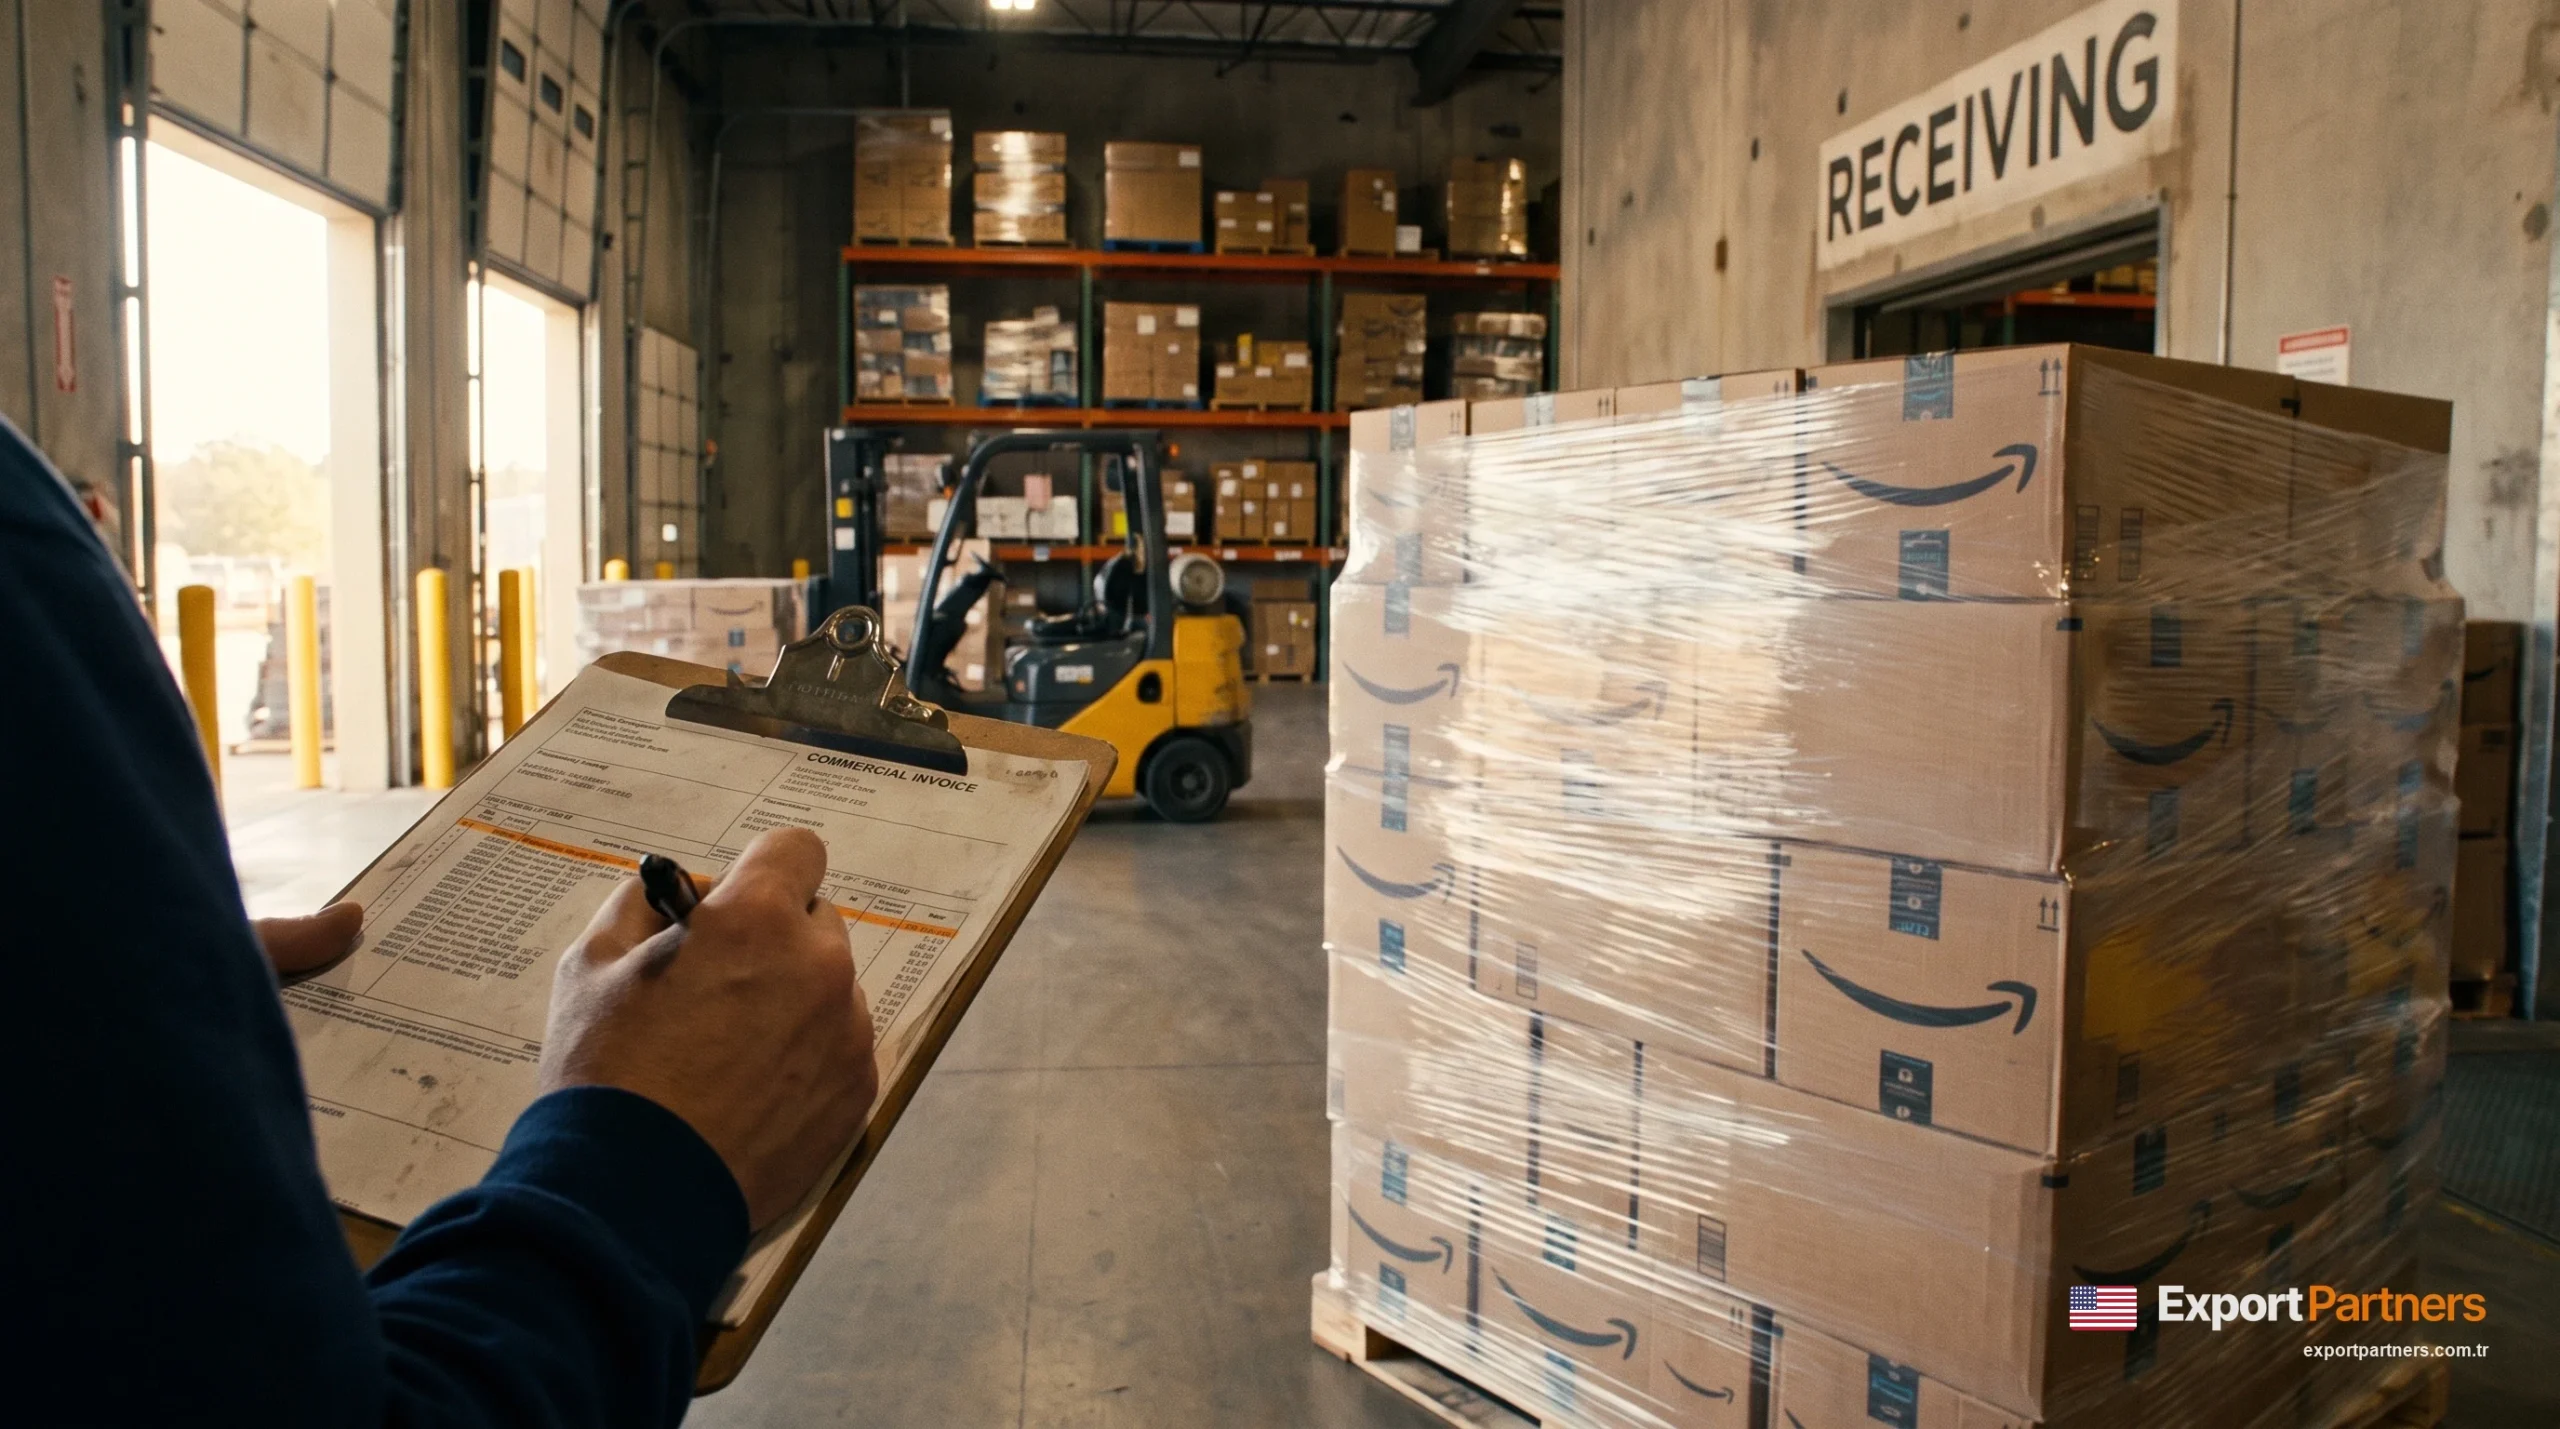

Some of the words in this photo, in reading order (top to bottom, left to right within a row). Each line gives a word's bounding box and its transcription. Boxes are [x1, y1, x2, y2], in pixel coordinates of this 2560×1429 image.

[1827, 12, 2159, 243] RECEIVING
[806, 752, 908, 781] COMMERCIAL
[911, 771, 979, 794] INVOICE
